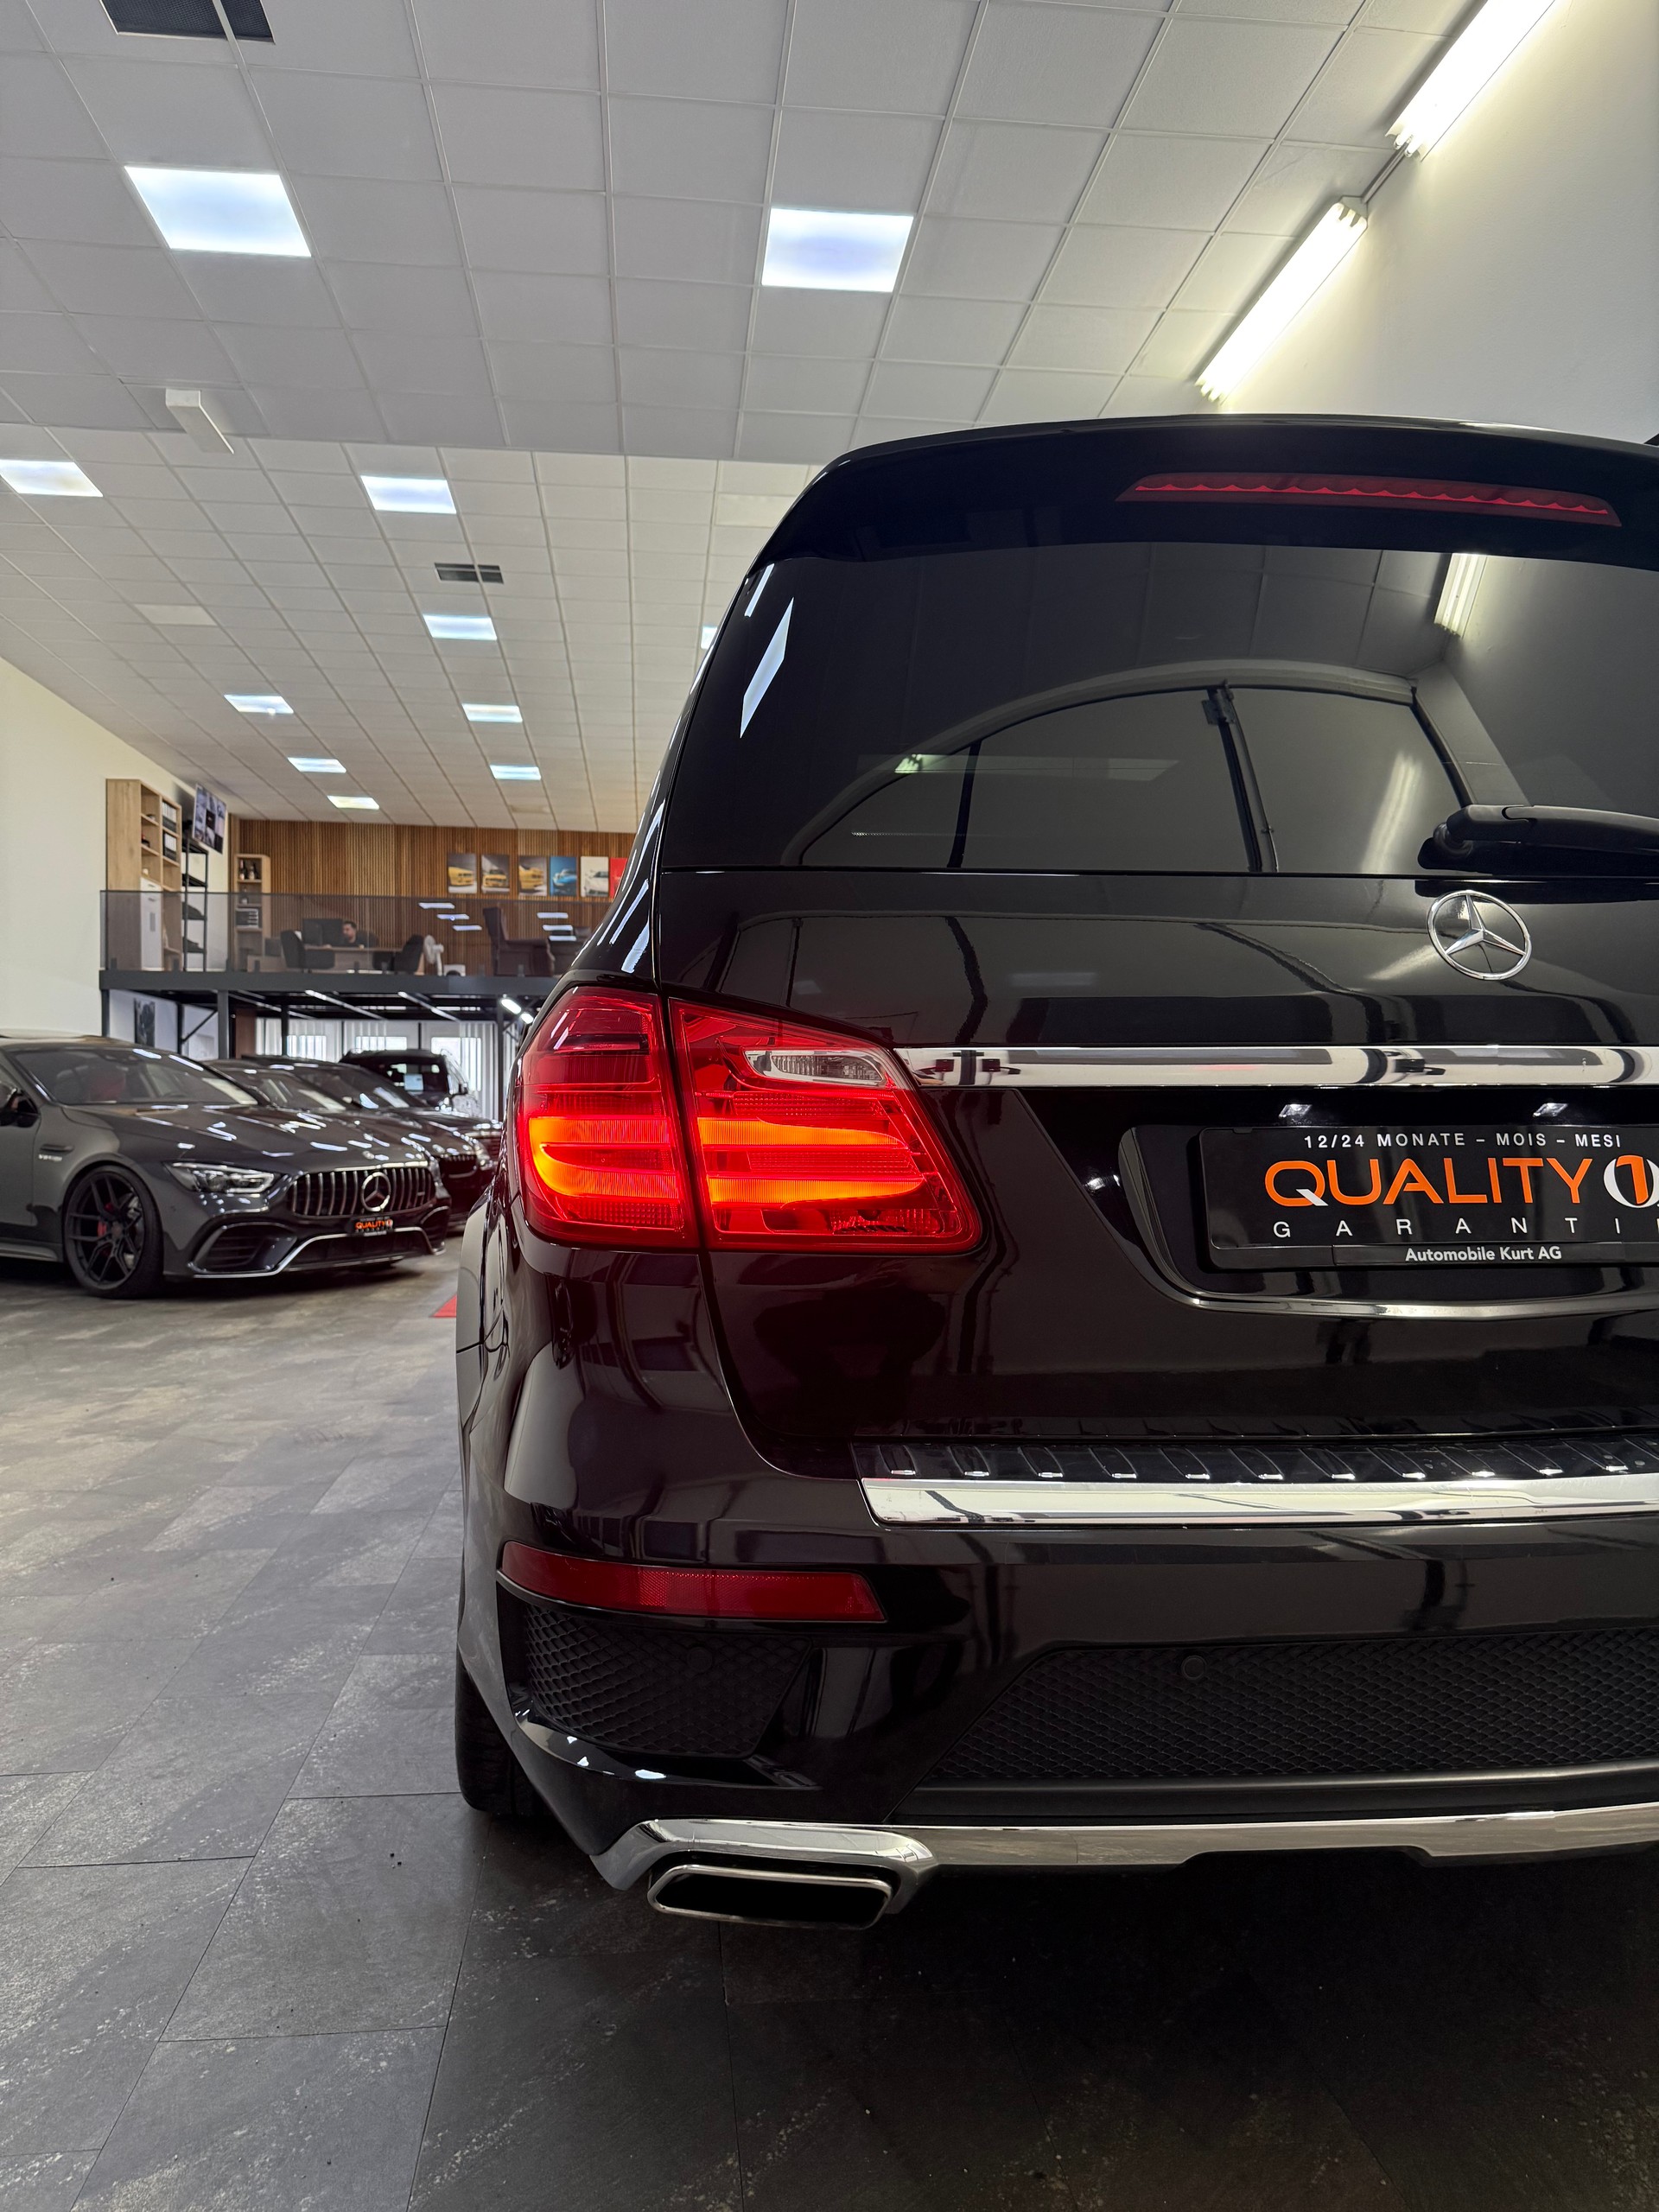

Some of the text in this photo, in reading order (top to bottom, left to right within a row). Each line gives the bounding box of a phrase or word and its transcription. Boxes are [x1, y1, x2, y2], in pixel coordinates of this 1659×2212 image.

[1304, 1134, 1365, 1148] 12/24
[1376, 1133, 1465, 1147] MONATE
[1496, 1133, 1547, 1147] MOIS
[1574, 1133, 1621, 1148] MESI
[1264, 1157, 1593, 1207] QUALITY
[1273, 1217, 1659, 1238] GARANTI
[1405, 1245, 1562, 1262] Automobile Kurt AG
